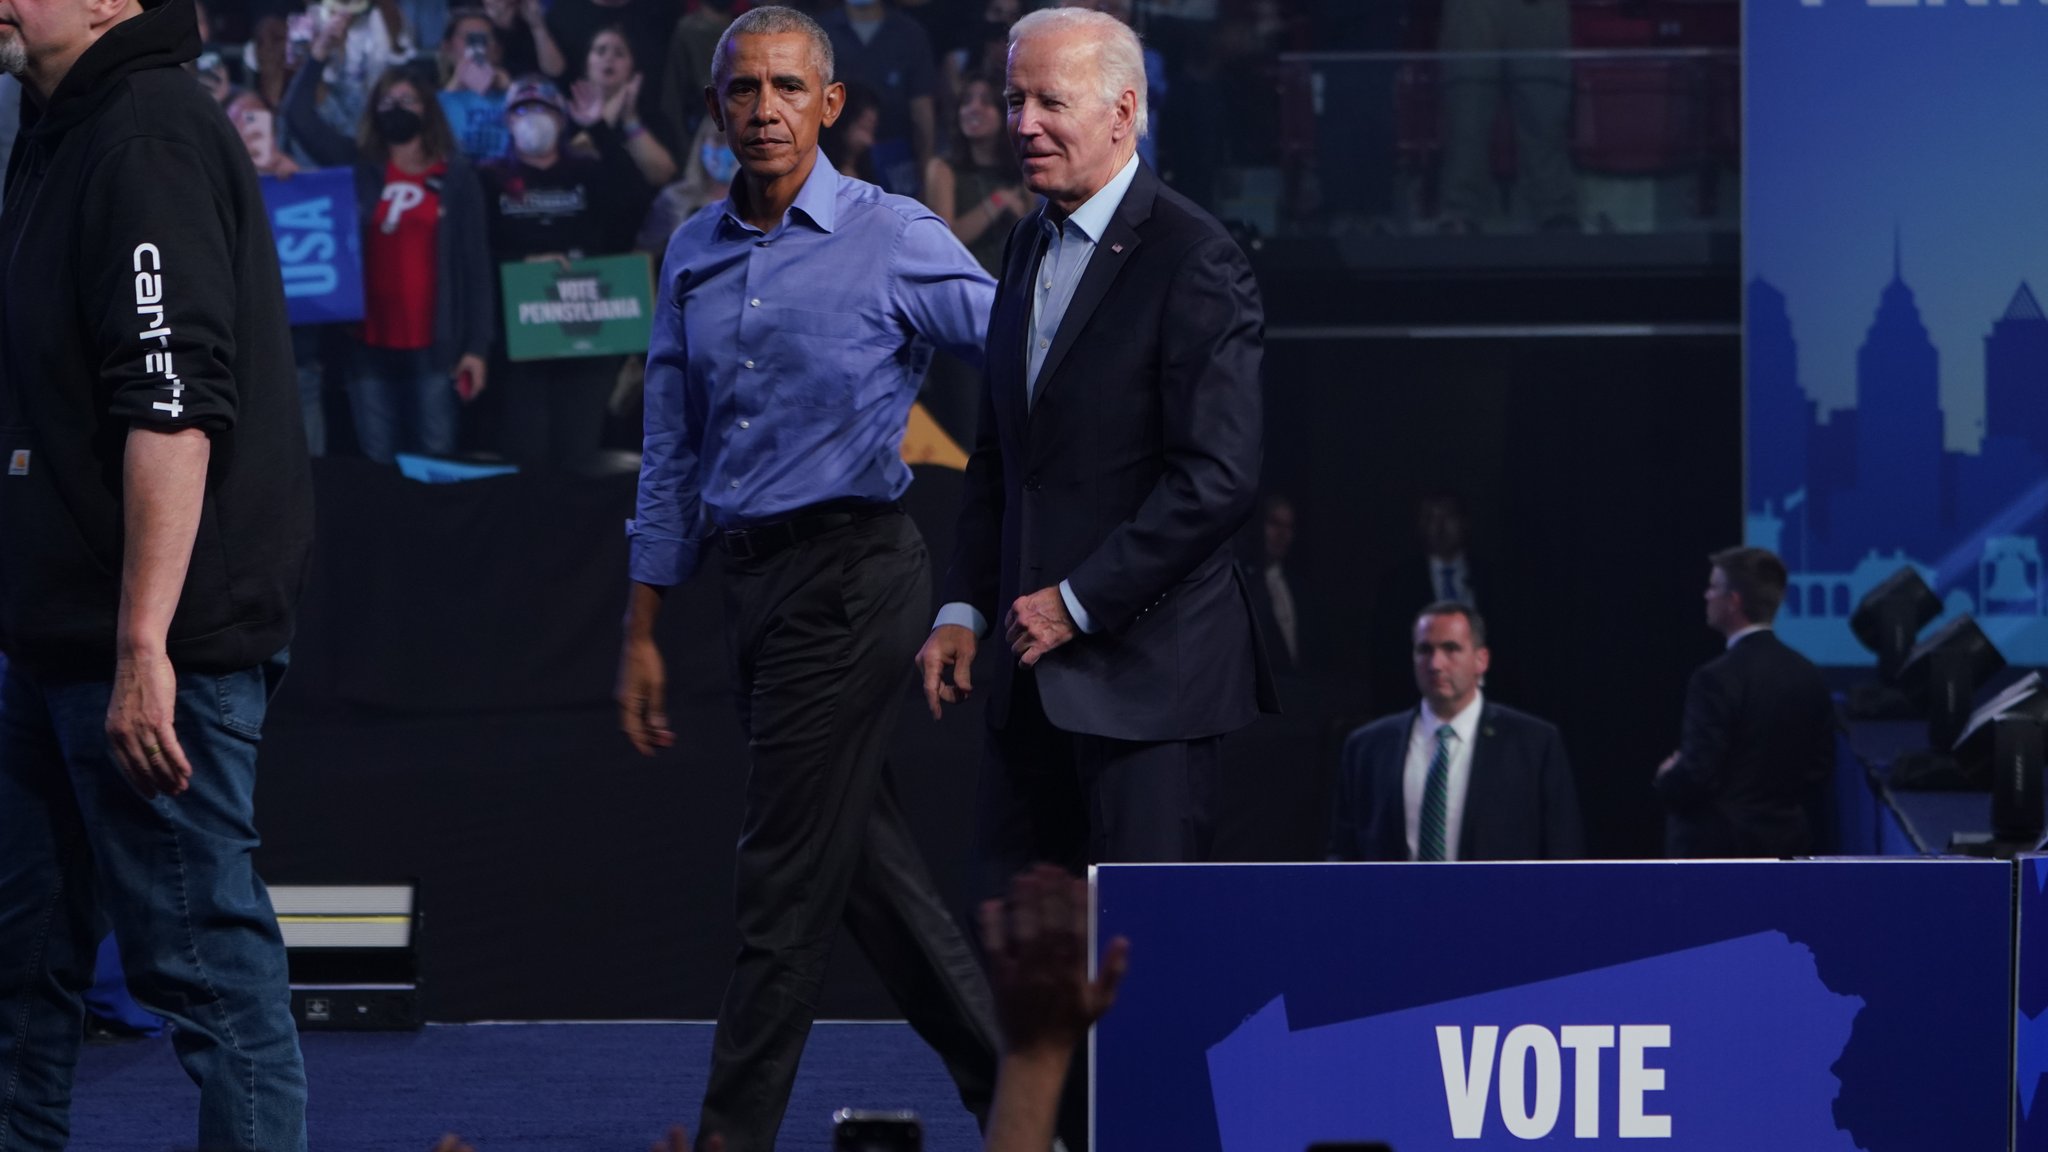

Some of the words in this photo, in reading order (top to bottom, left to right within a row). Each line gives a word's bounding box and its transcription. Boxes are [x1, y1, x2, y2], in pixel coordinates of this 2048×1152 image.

[381, 181, 424, 234] P
[274, 196, 336, 297] USA
[518, 299, 640, 323] PENNSYLVANIA
[557, 279, 600, 300] VOTE
[133, 242, 185, 418] carhatt
[1435, 1024, 1672, 1140] VOTE
